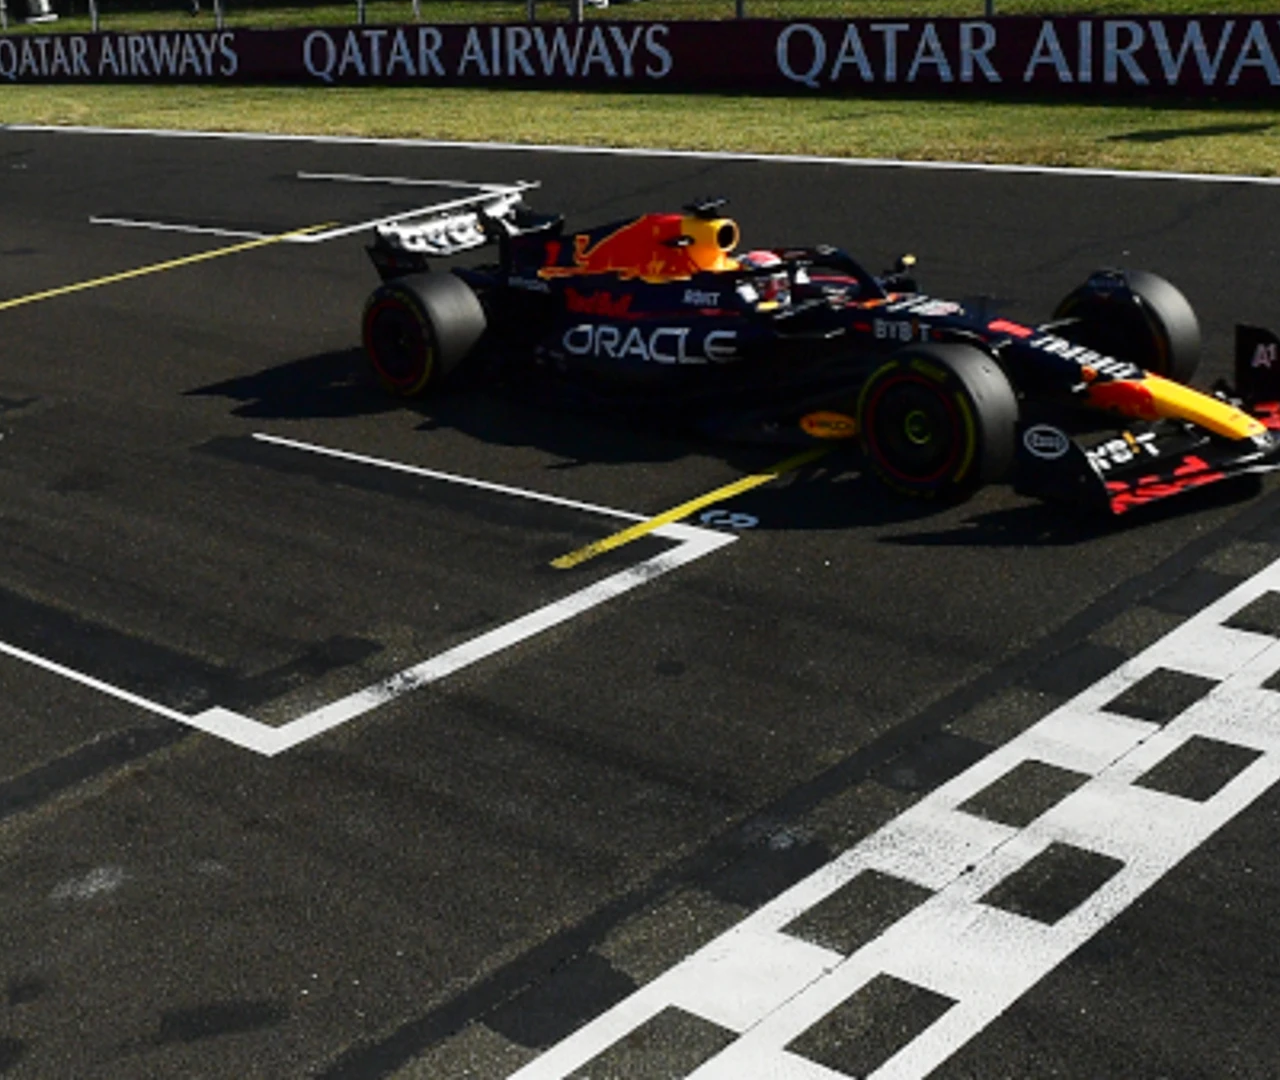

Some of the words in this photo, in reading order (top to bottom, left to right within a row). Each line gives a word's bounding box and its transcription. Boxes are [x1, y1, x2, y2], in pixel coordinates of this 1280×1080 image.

[99, 32, 238, 76] AIRWAYS
[301, 27, 445, 81] QATAR
[458, 25, 672, 78] AIRWAYS
[775, 20, 1002, 86] QATAR
[563, 323, 738, 364] ORACLE
